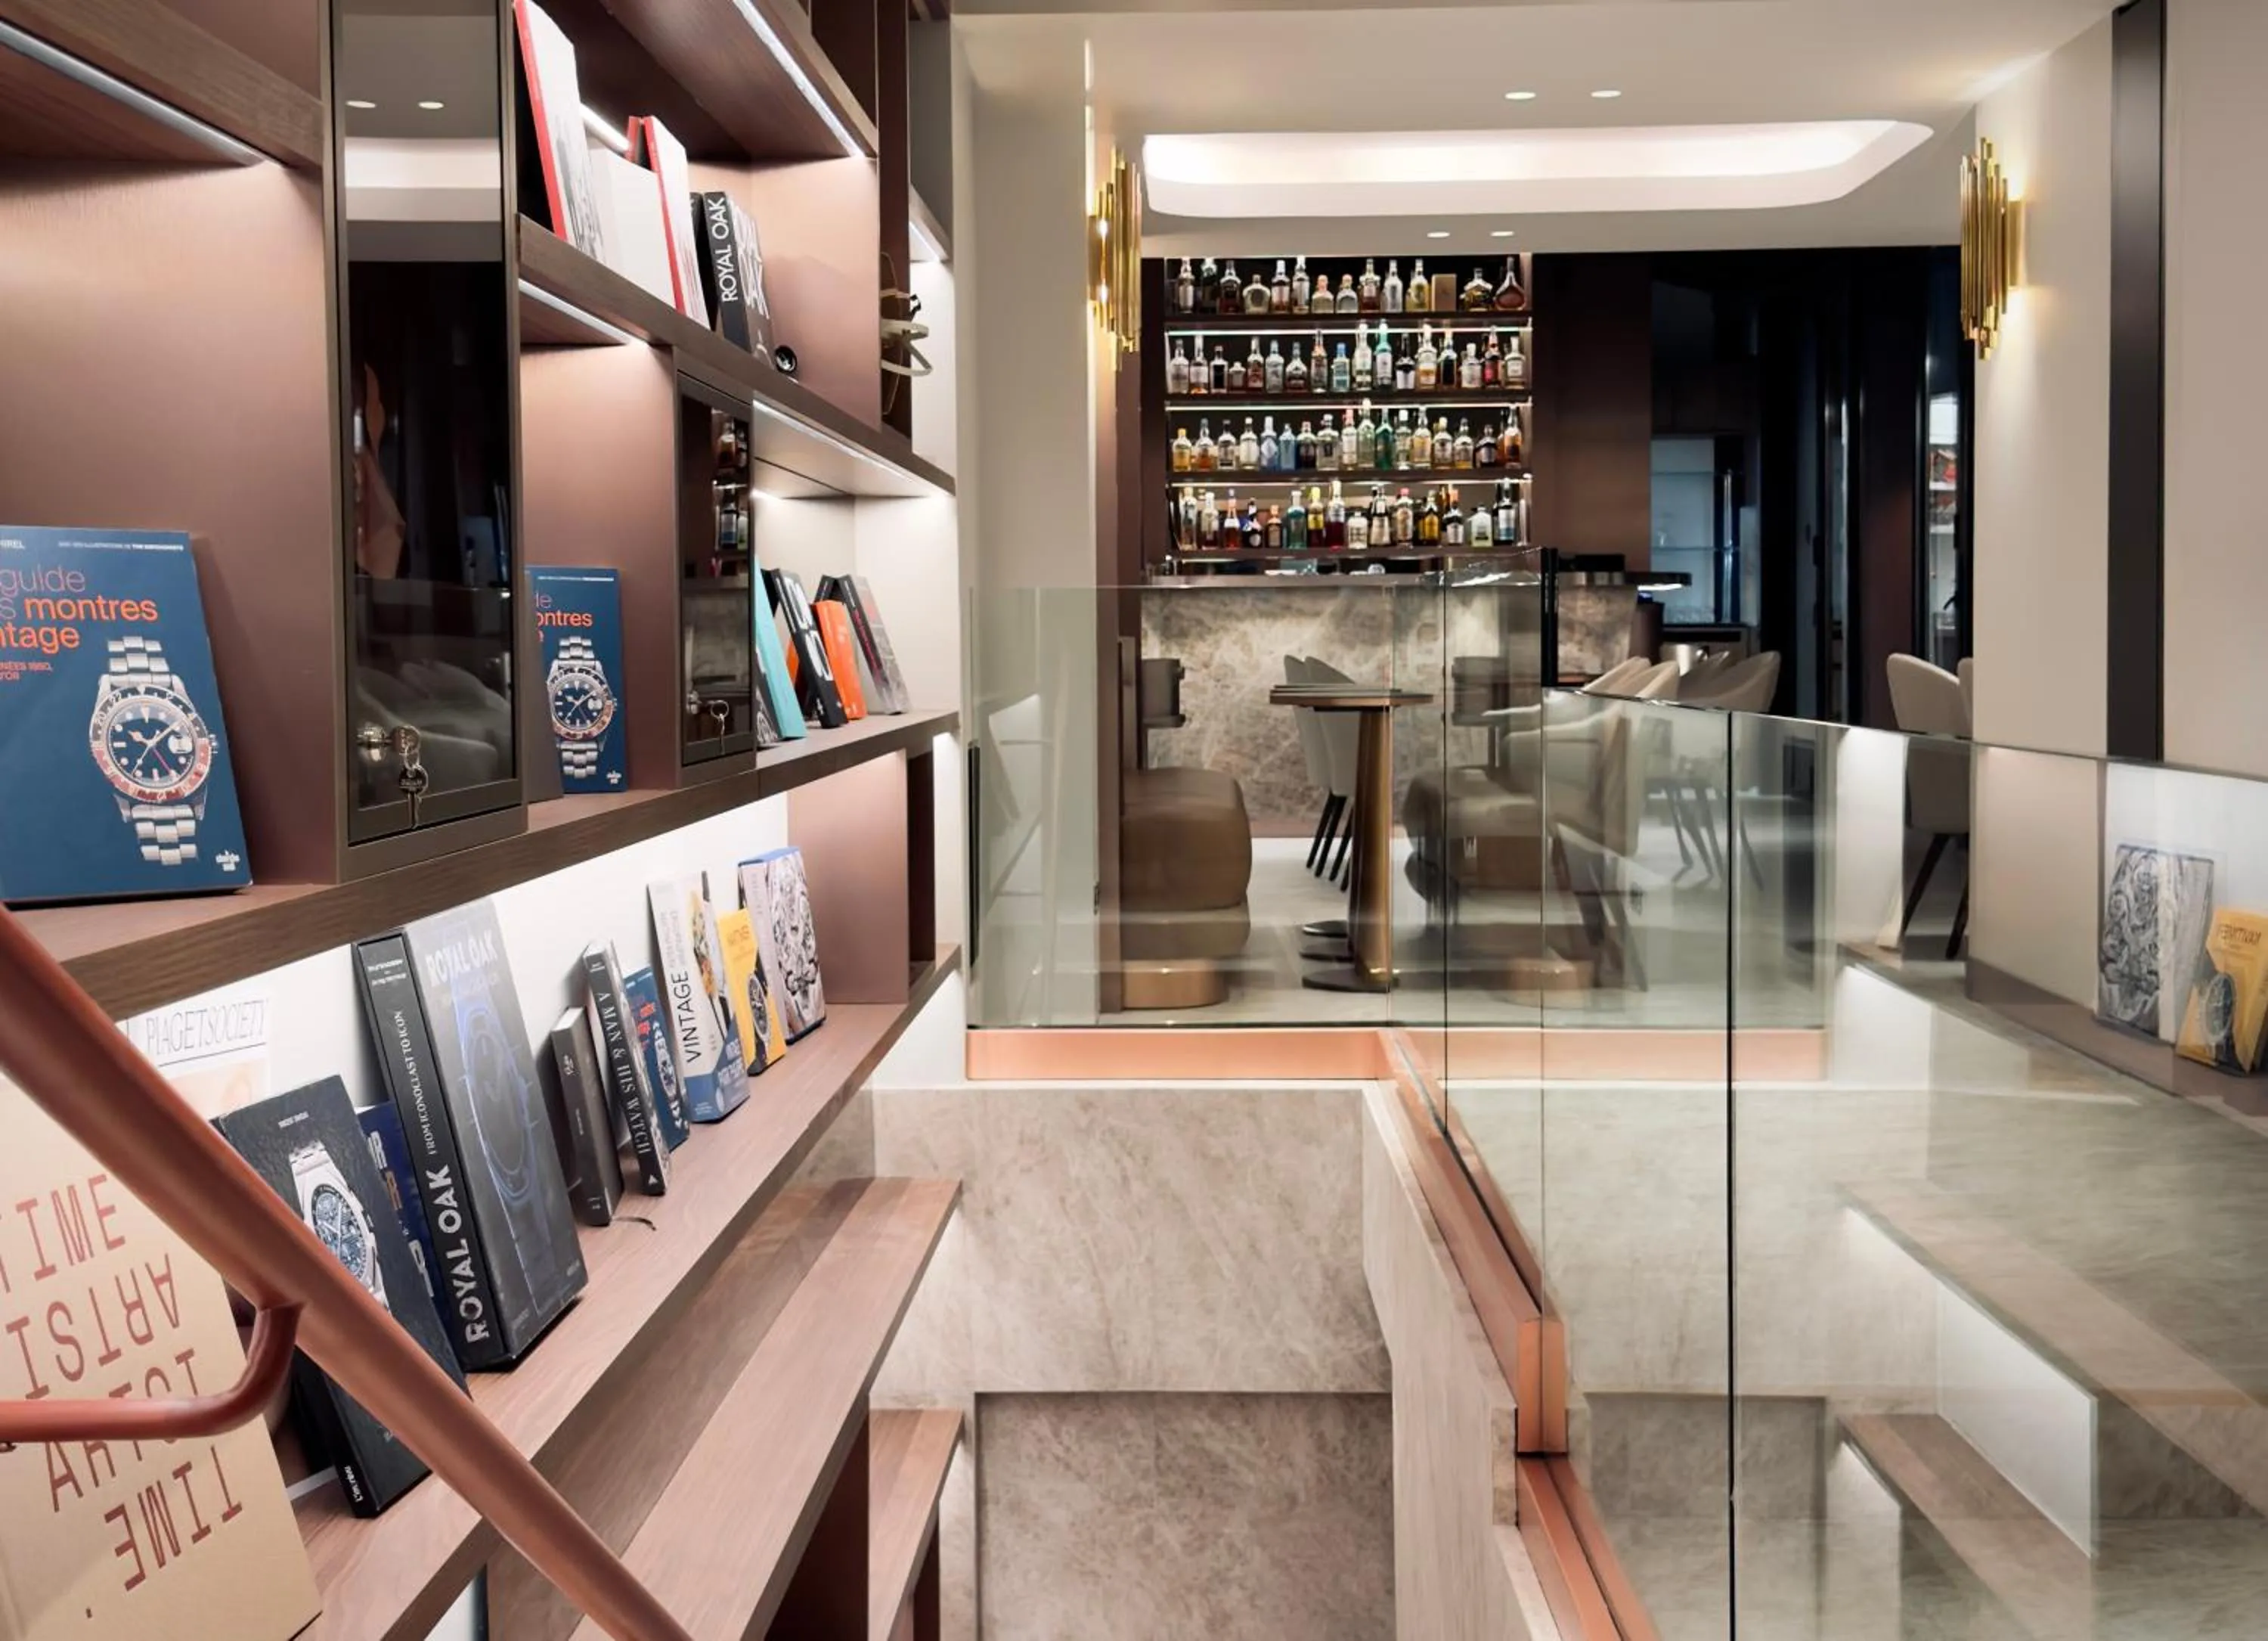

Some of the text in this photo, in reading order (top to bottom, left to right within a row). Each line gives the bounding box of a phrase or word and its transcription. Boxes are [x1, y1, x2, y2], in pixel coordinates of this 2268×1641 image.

[708, 197, 739, 302] ROYAL OAK
[0, 563, 85, 598] guide
[23, 594, 159, 622] montres
[536, 610, 593, 627] ontres
[425, 941, 470, 988] ROYAL
[468, 929, 498, 969] OAK
[595, 991, 612, 1003] A
[603, 1007, 623, 1043] MAN
[671, 970, 703, 1063] VINTAGE
[612, 1047, 627, 1059] &
[616, 1064, 637, 1094] HIS
[626, 1097, 652, 1154] WATCH
[425, 1164, 462, 1234] OAK
[0, 1174, 125, 1294] IME
[445, 1238, 491, 1344] ROYAL
[104, 1444, 243, 1592] TIME
